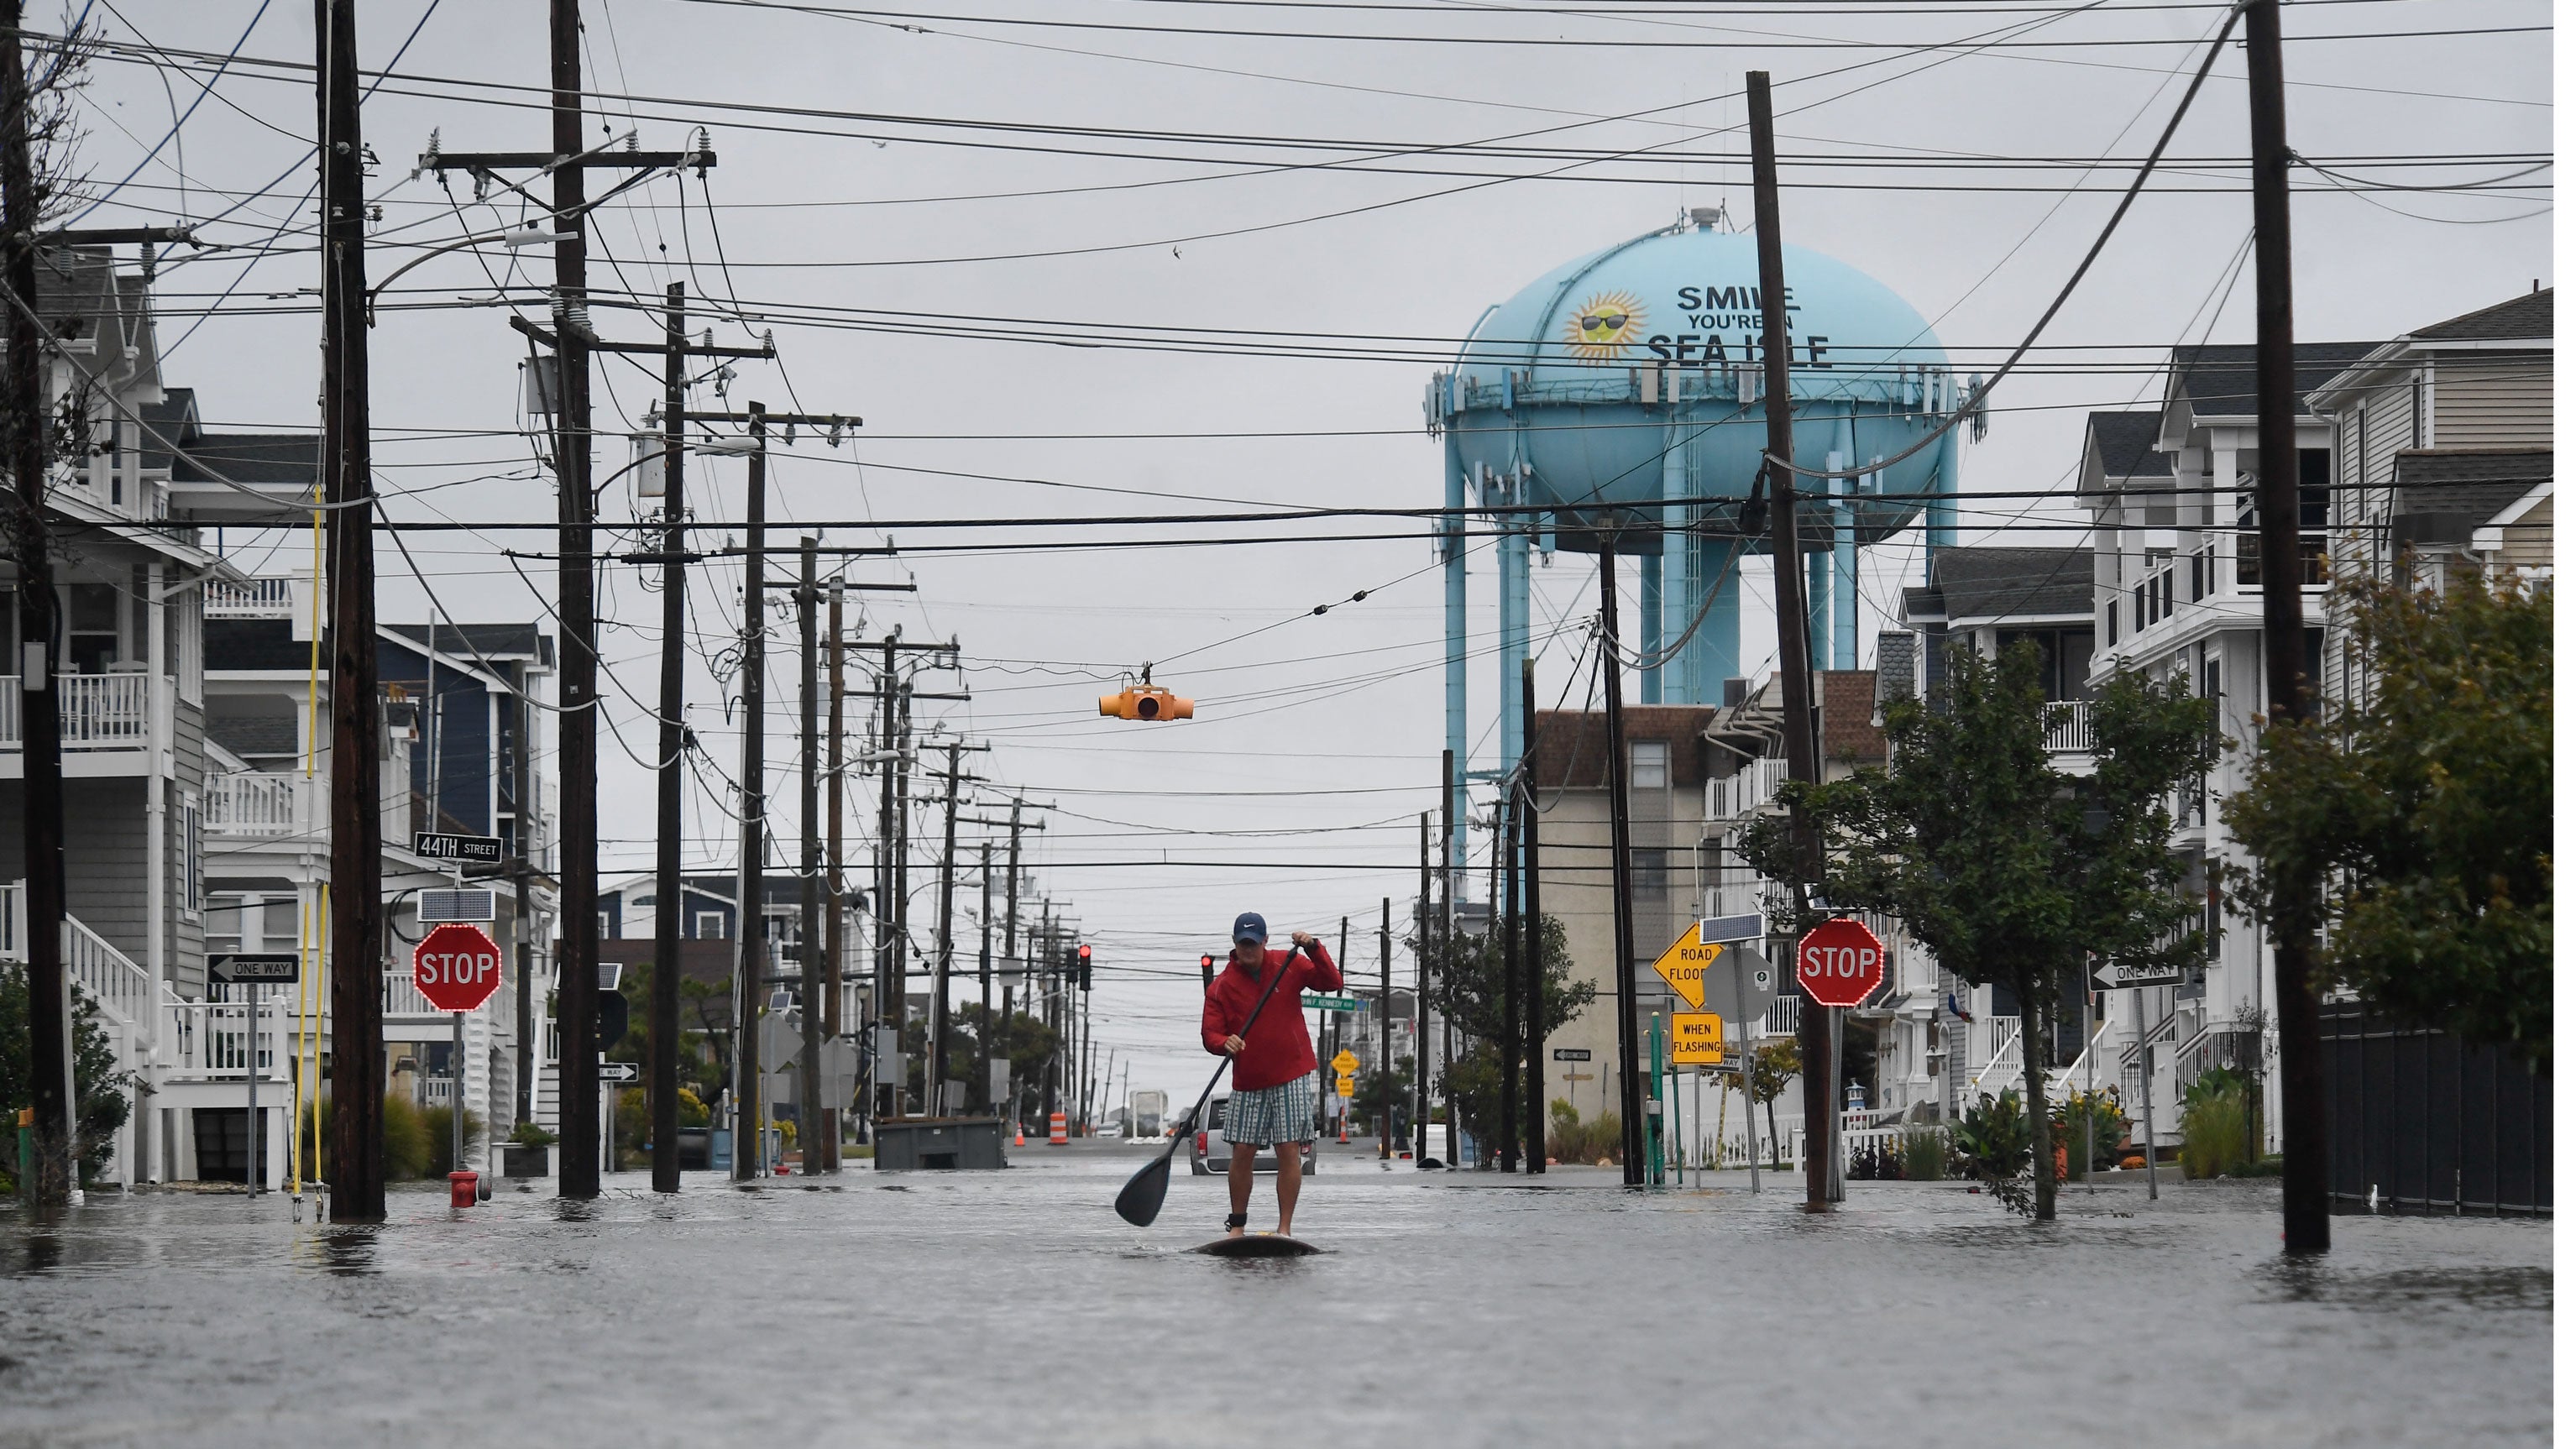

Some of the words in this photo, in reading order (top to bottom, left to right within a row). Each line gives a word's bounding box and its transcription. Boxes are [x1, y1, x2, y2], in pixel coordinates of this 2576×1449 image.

[1688, 314, 1763, 330] YOU'RE
[1647, 334, 1729, 367] SEA
[421, 836, 458, 856] 44TH
[463, 843, 496, 855] STREET
[1681, 949, 1712, 960] ROAD
[1804, 946, 1877, 978] STOP
[235, 963, 259, 974] ONE
[264, 963, 289, 974] WAY
[420, 952, 495, 984] STOP
[2117, 966, 2144, 980] ONE
[1683, 1023, 1711, 1034] WHEN
[1673, 1041, 1720, 1052] FLASHING
